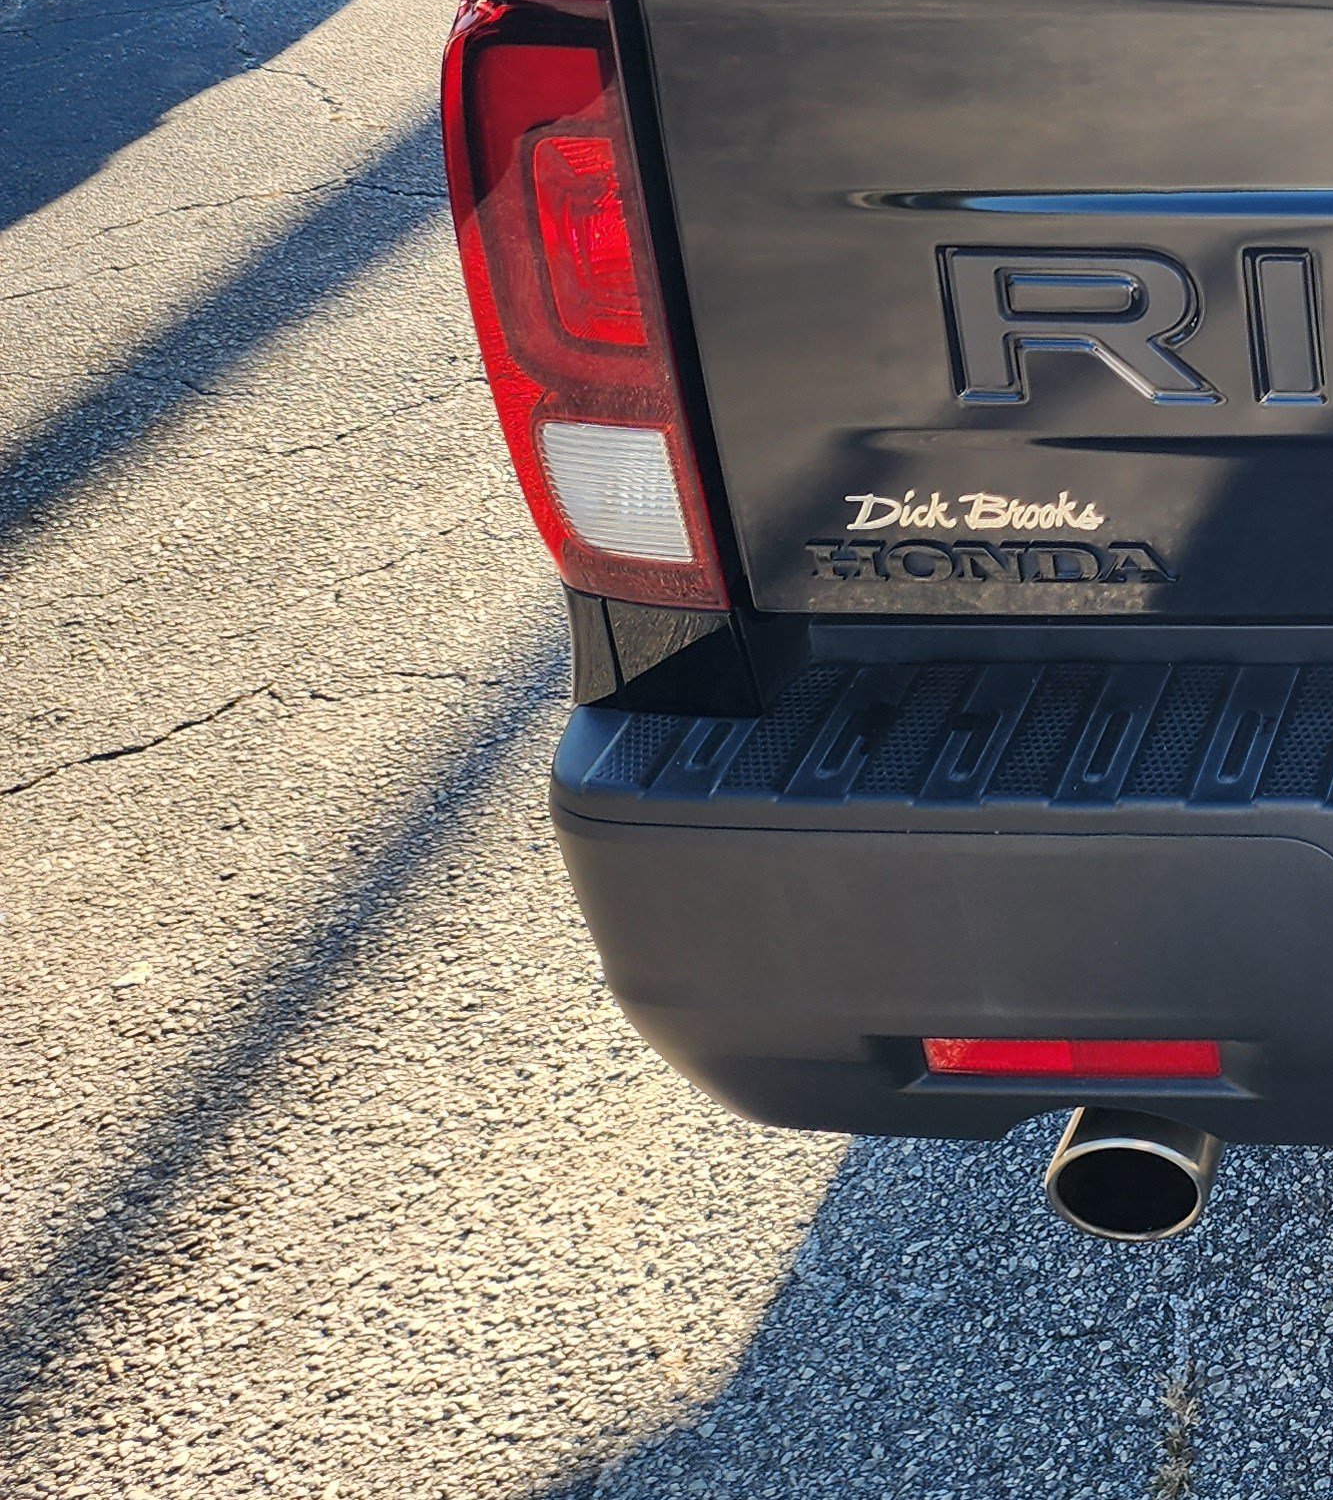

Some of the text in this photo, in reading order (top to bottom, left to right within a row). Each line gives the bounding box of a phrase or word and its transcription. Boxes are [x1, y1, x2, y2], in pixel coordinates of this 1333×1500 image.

[844, 489, 1106, 532] Dick Brooks
[804, 538, 1181, 584] HONDA
